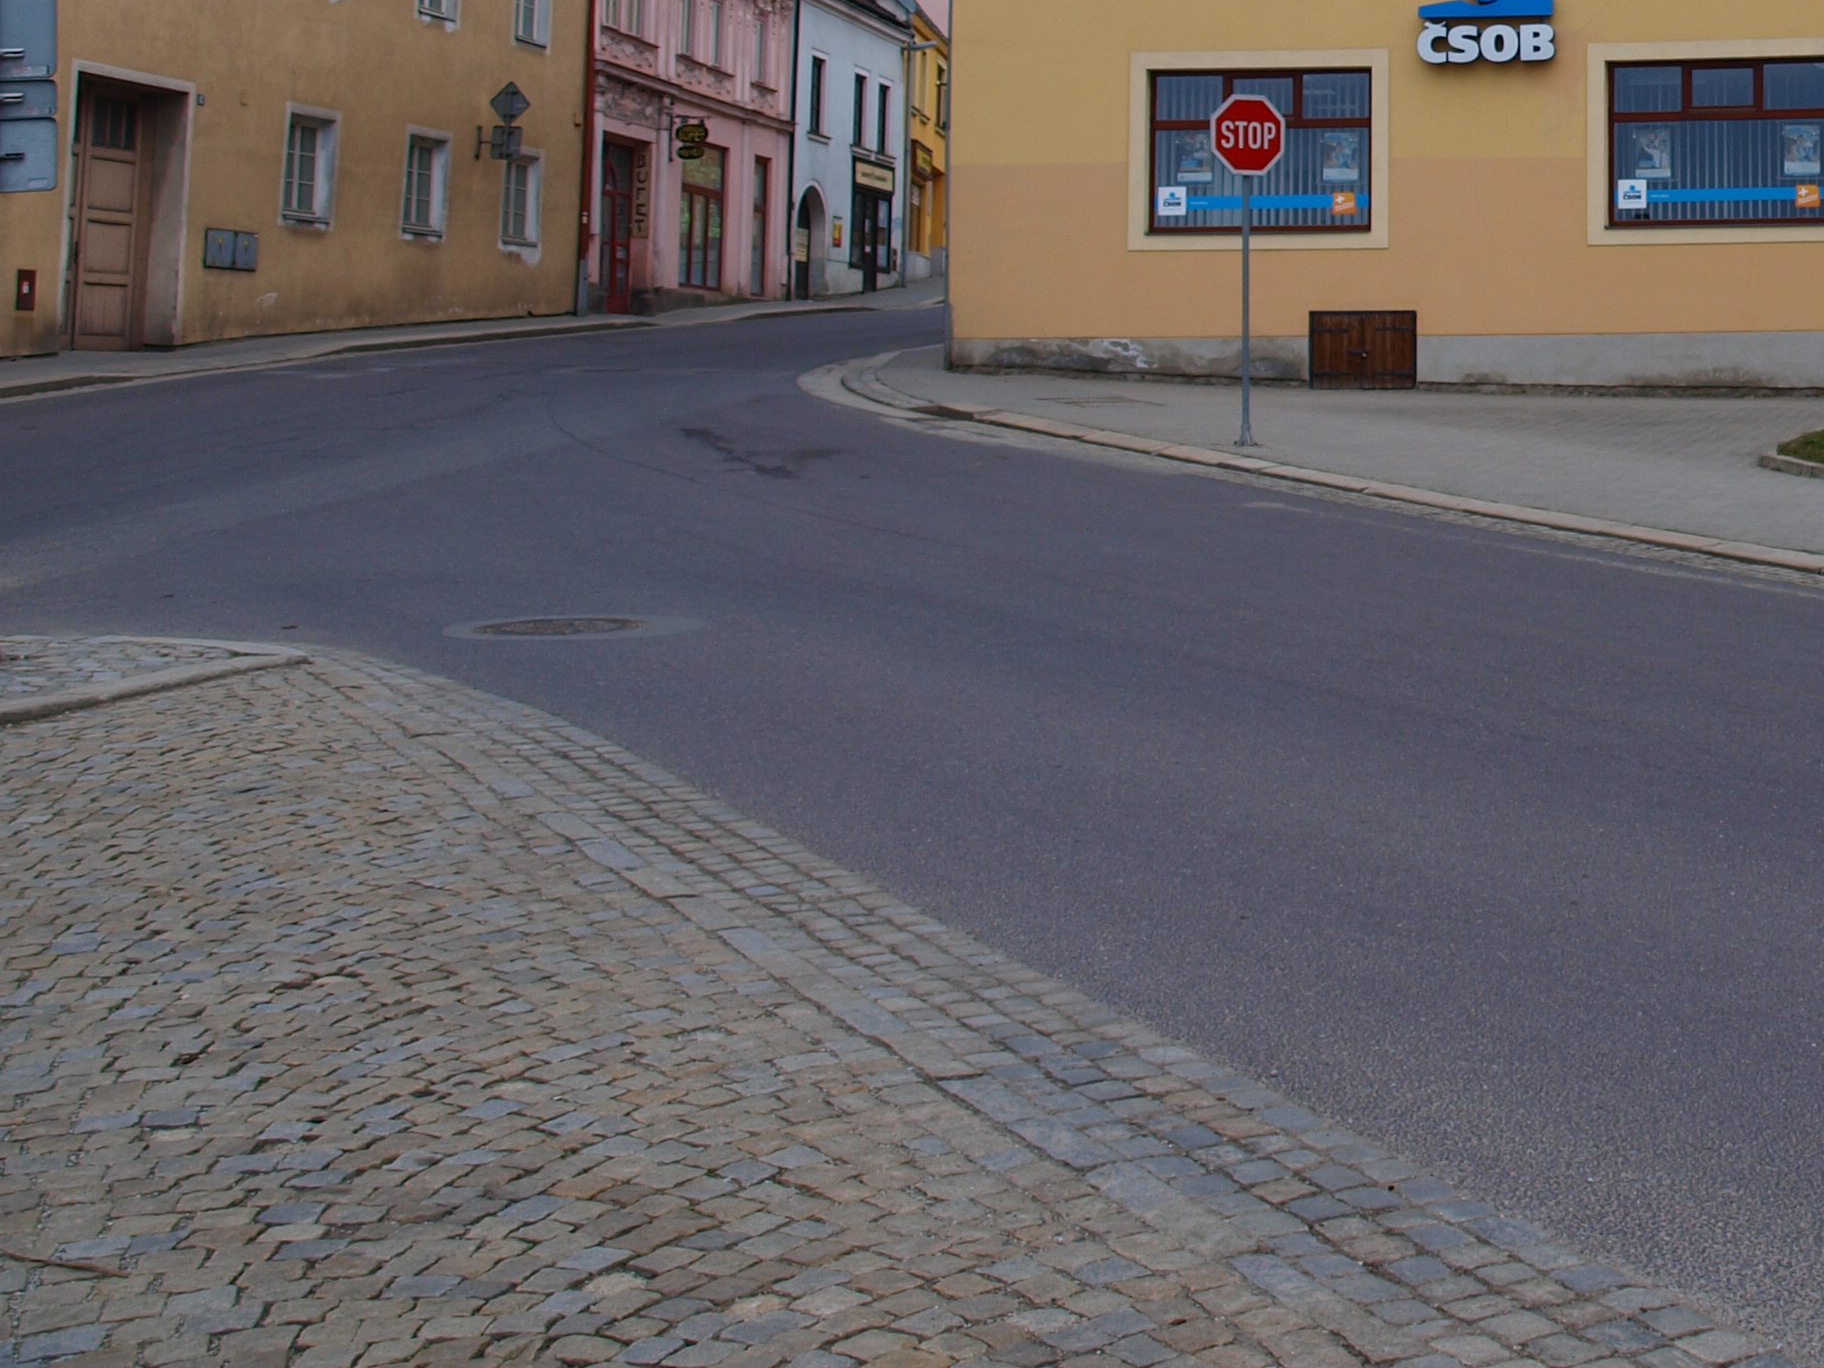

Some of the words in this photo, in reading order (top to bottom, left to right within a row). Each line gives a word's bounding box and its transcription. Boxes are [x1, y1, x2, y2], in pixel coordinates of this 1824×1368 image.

[1416, 21, 1556, 64] ČSOB
[1220, 120, 1277, 150] STOP
[634, 153, 648, 233] BUFET
